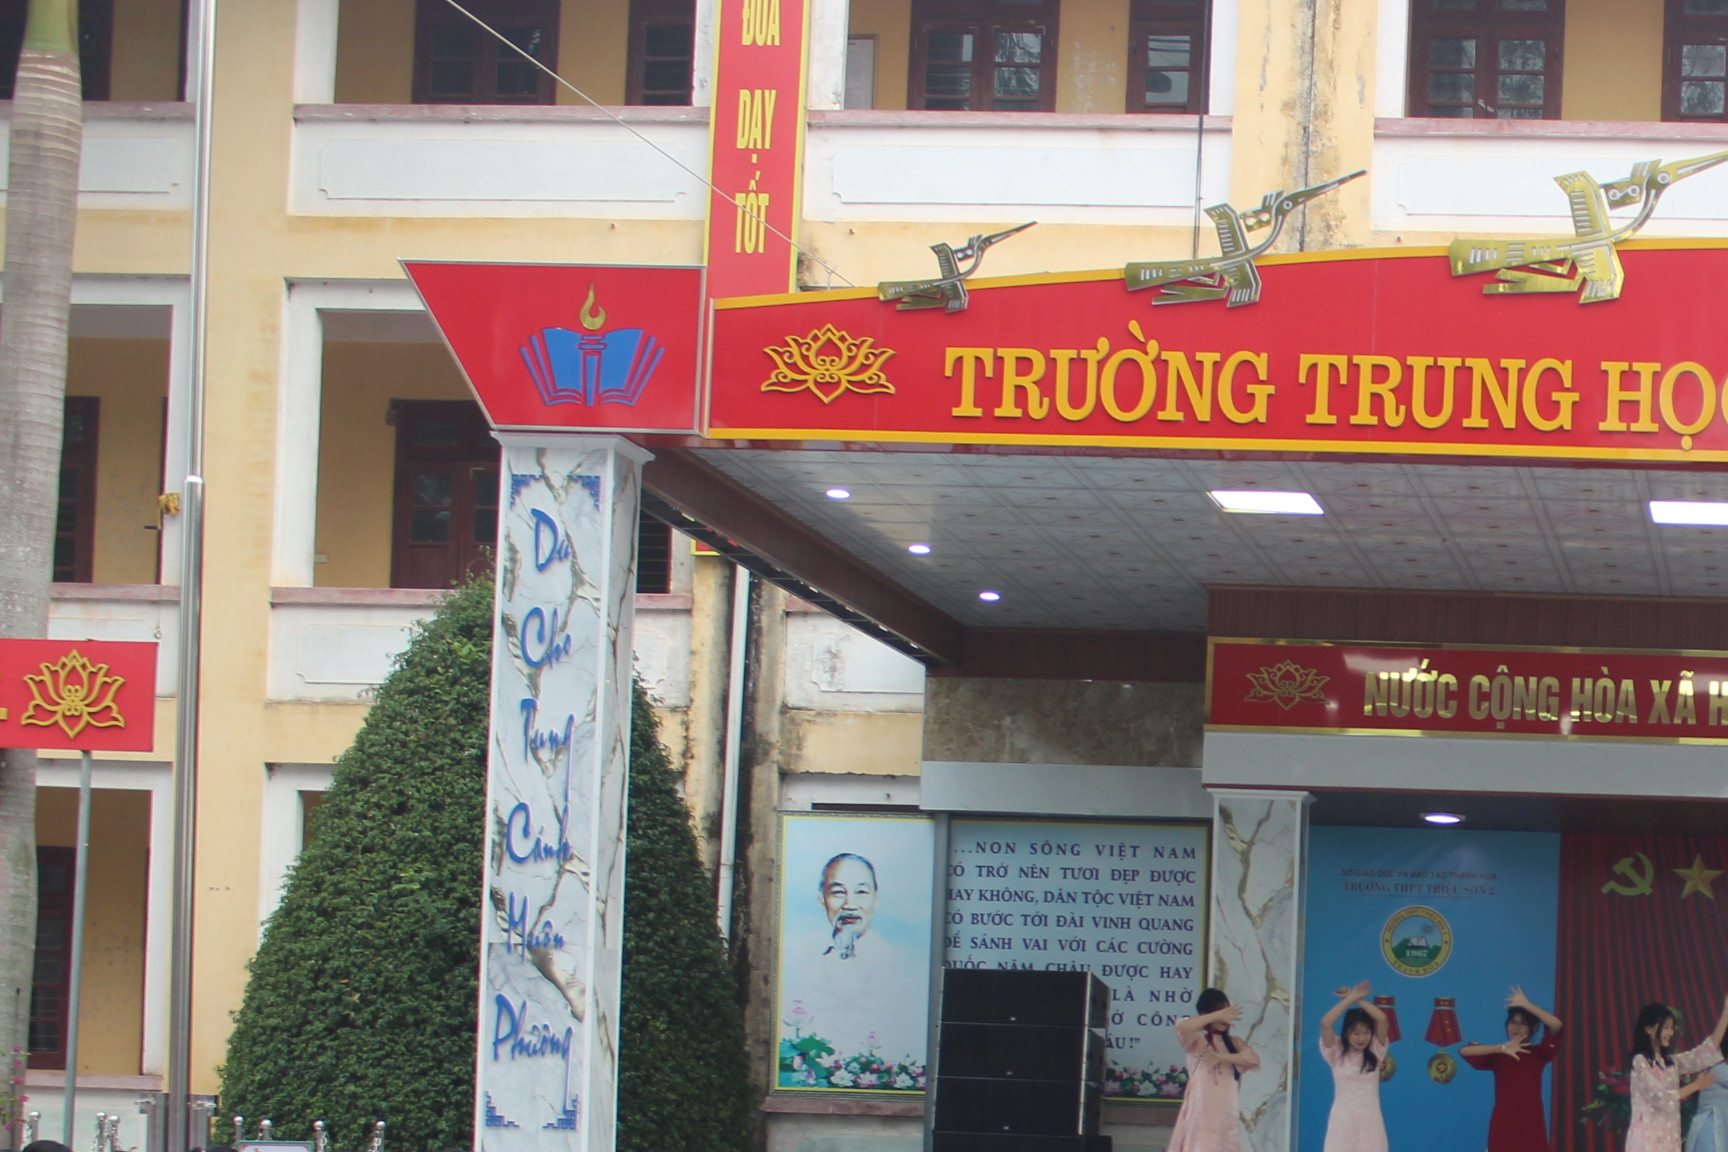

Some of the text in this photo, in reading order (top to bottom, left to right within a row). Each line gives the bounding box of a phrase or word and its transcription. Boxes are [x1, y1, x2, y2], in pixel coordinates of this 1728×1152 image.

[736, 89, 777, 164] DẠY
[735, 170, 770, 254] TỐT
[944, 320, 1276, 424] TRƯỜNG
[1298, 355, 1580, 431] TRUNG
[1363, 658, 1459, 719] NƯỚC
[1469, 665, 1560, 729] CỘNG
[1570, 666, 1638, 724] HÒA
[1648, 670, 1697, 725] XÃ
[1029, 841, 1081, 856] SÔNG
[1095, 842, 1141, 860] VIỆT
[1153, 846, 1197, 860] NAM
[1019, 864, 1050, 879] NÊN
[1060, 866, 1100, 881] TƯƠI
[1110, 868, 1140, 885] ĐẸP
[1150, 869, 1196, 887] ĐƯỢC
[978, 887, 1039, 906] KHÔNG,
[1043, 889, 1077, 904] DÂN
[1082, 890, 1114, 908] TỘC
[1118, 891, 1154, 910] VIỆT
[1158, 894, 1195, 907] NAM
[507, 890, 567, 964] Muôn
[971, 910, 1014, 926] BƯỚC
[1020, 911, 1049, 927] TỚI
[1056, 912, 1084, 928] ĐÀI
[1091, 915, 1132, 929] VINH
[1138, 916, 1195, 931] QUANG
[970, 935, 1012, 949] SÁNH
[1022, 938, 1048, 951] VAI
[1058, 936, 1087, 952] VỚI
[1096, 937, 1128, 953] CÁC
[1137, 938, 1193, 955] CƯỜNG
[1102, 963, 1150, 983] ĐƯỢC
[1160, 966, 1193, 979] HAY
[1112, 986, 1193, 1003] LÀ NHỜ
